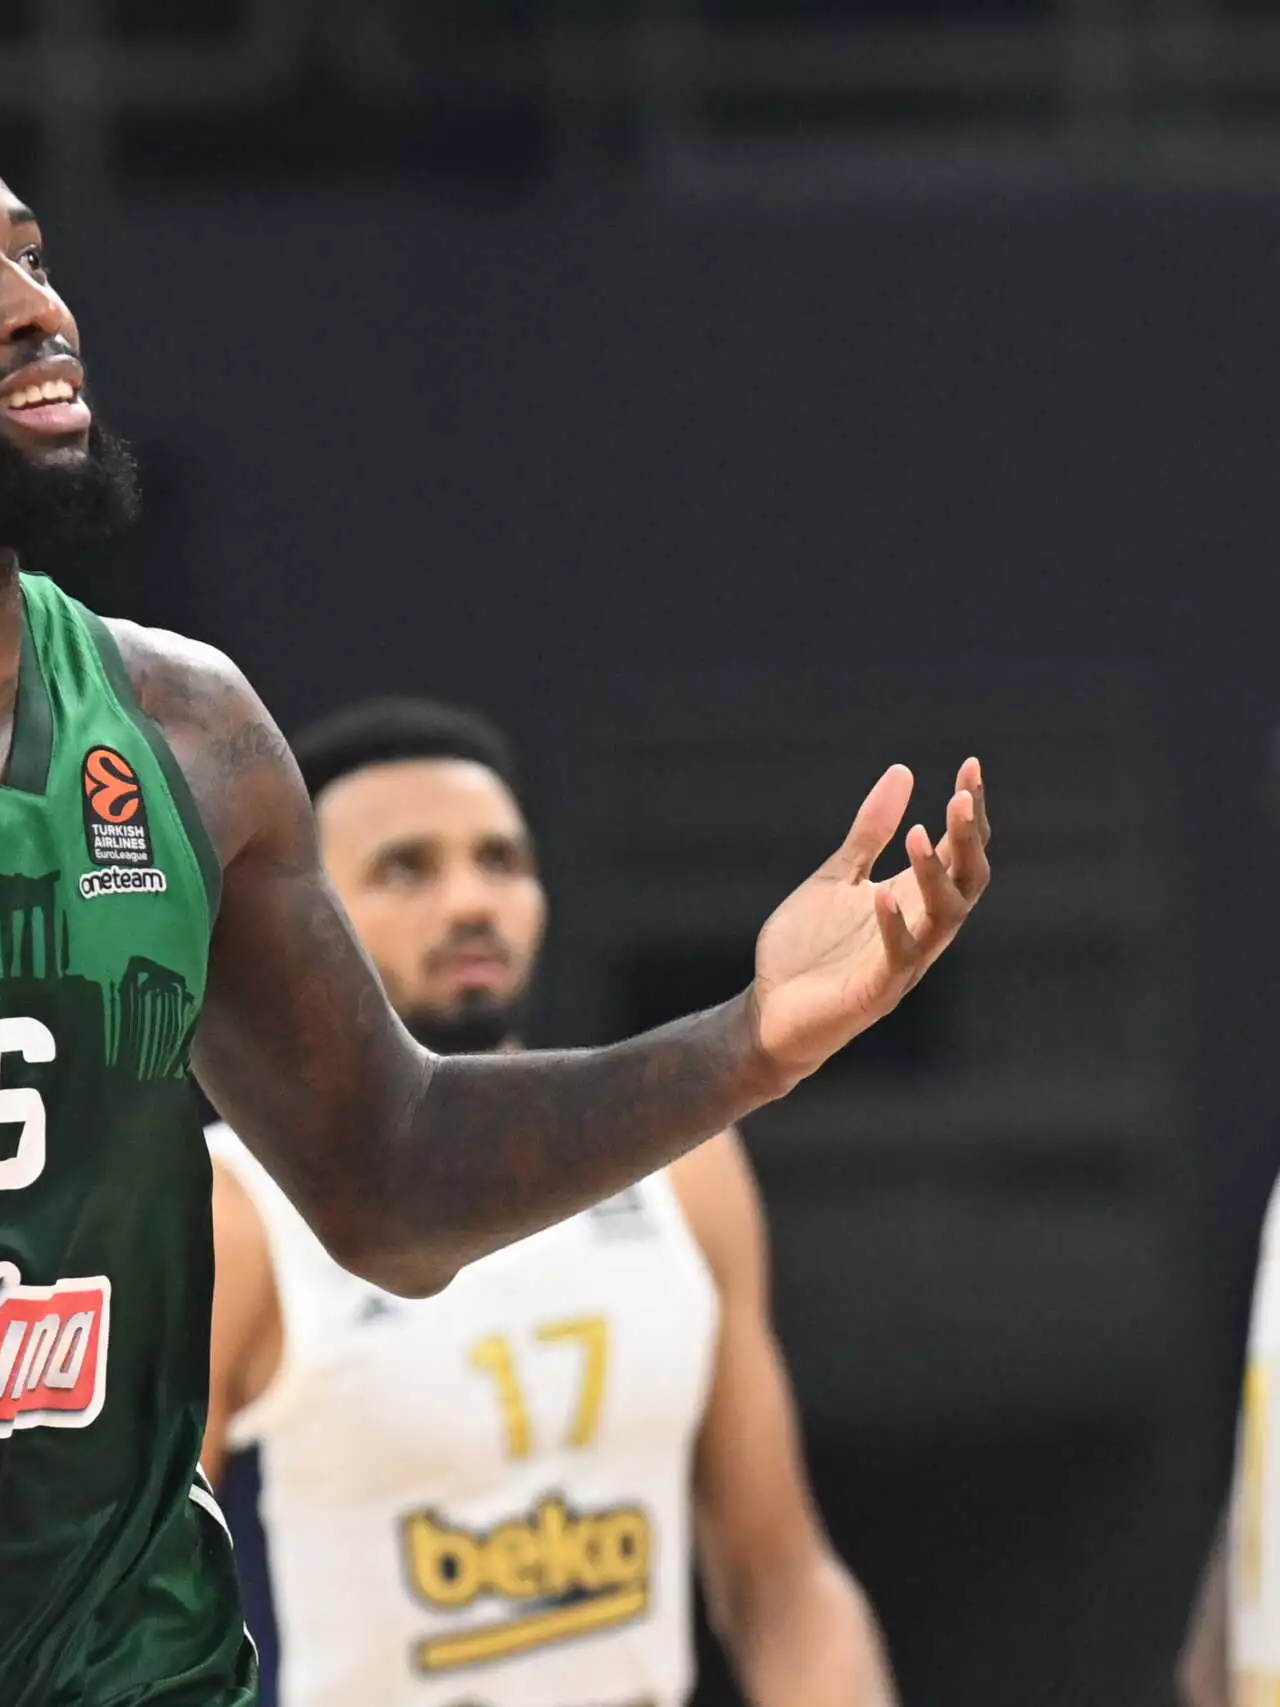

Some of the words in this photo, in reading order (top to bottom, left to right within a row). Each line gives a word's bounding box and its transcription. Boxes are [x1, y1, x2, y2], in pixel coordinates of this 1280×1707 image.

[92, 824, 144, 837] TURKISH
[94, 837, 146, 850] AIRLINES
[95, 849, 148, 862] EuroLeague
[81, 871, 163, 895] oneteam
[466, 1313, 610, 1462] 17
[402, 1495, 650, 1606] beko
